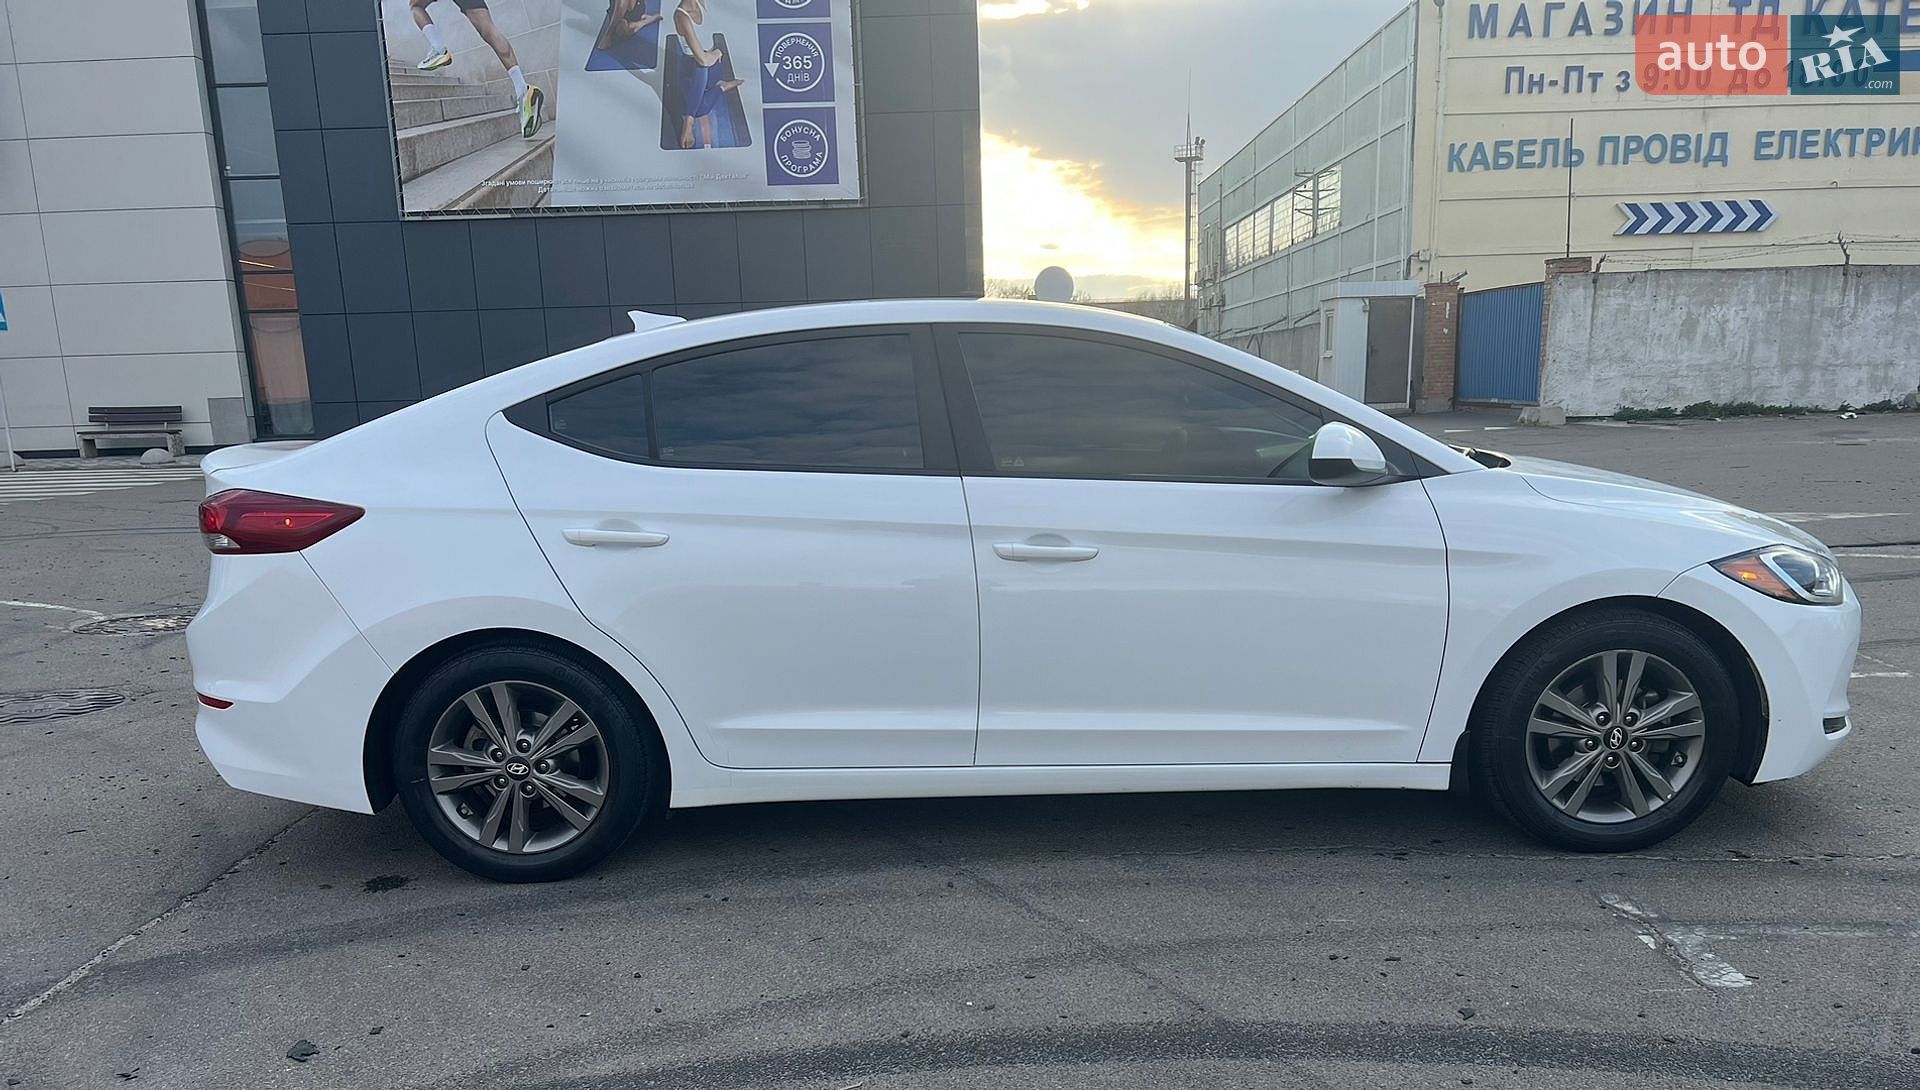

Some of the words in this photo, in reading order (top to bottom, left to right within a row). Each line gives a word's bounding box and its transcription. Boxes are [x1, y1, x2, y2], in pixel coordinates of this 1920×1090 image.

[1467, 0, 1693, 39] МАГАЗИН
[775, 36, 820, 58] ПОВЕРНЕННЯ
[782, 55, 813, 70] 365
[1504, 65, 1604, 94] Пн-Пт
[780, 125, 821, 142] БОНУСНА
[781, 151, 823, 174] ПРОГРАМА
[1447, 138, 1585, 172] КАБЕЛЬ
[1598, 131, 1729, 168] ПРОВІД
